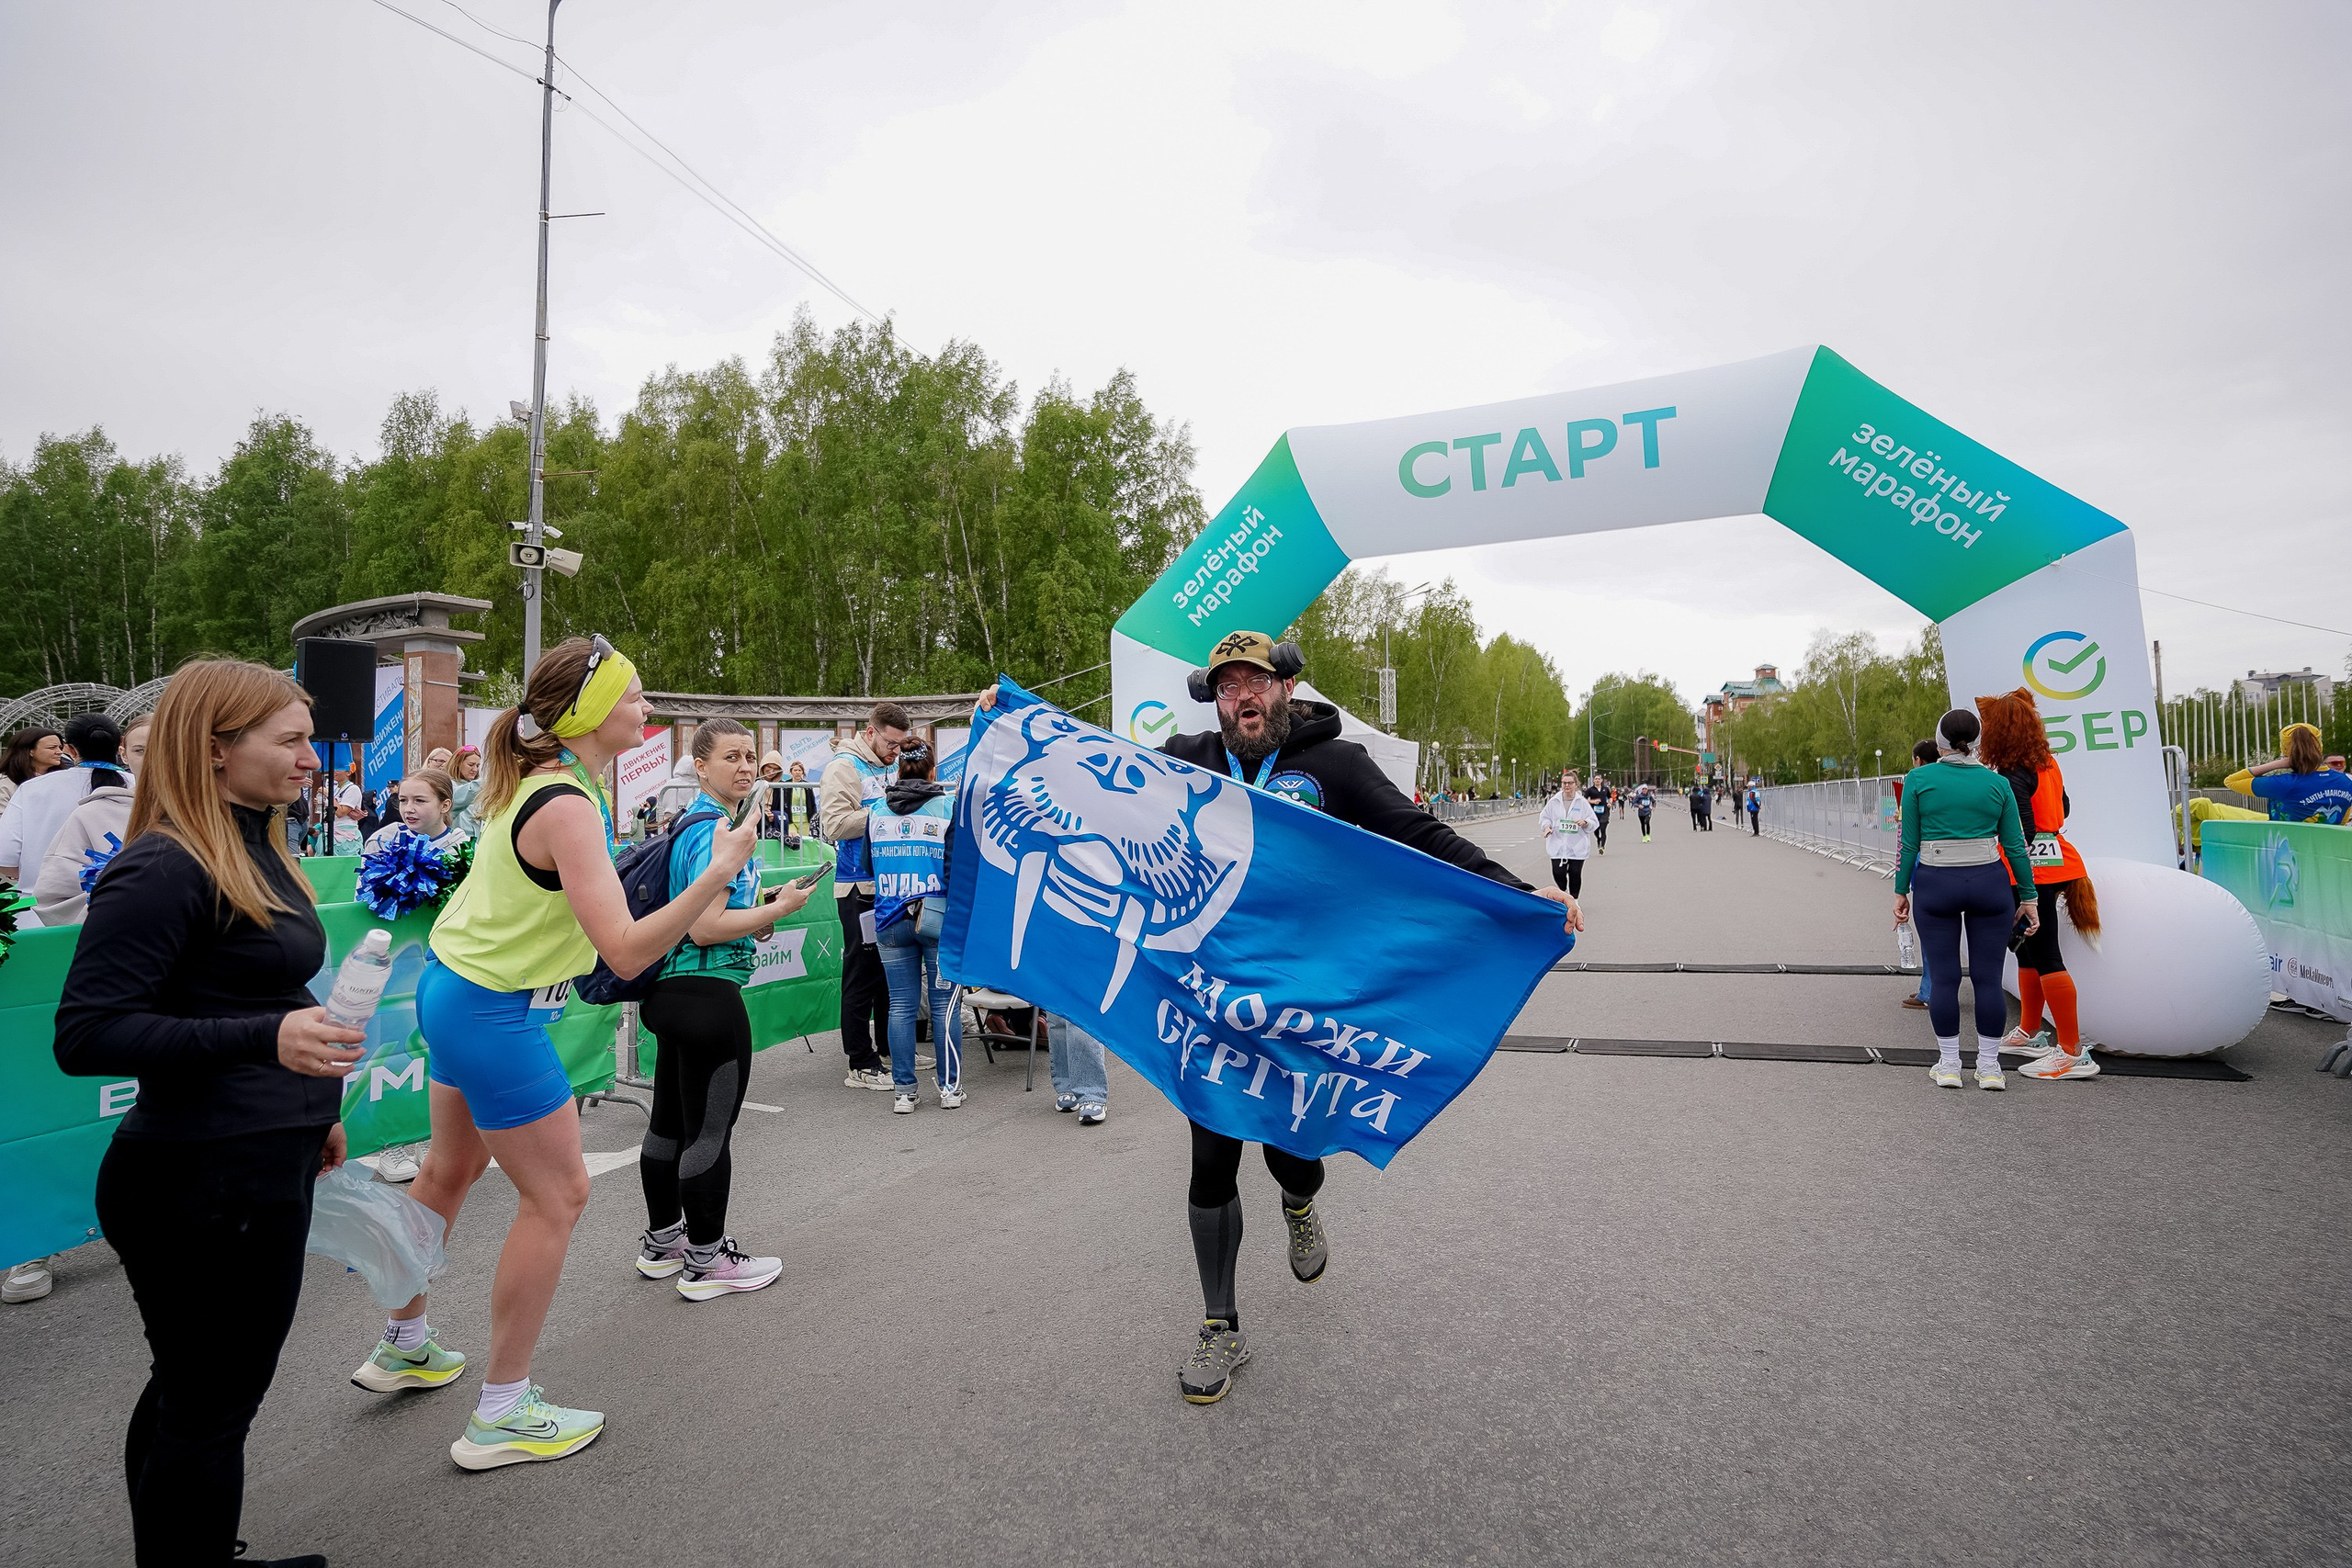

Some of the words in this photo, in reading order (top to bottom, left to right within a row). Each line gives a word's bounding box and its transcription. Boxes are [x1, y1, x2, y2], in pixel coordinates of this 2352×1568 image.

[1398, 405, 1678, 499] СТАРТ
[1851, 423, 2011, 523] зелёный
[1828, 446, 1983, 549] марафон
[1172, 504, 1265, 609] зелёный
[1187, 525, 1283, 627] марафон
[375, 675, 404, 712] СТИВАЛЬ
[789, 735, 813, 751] БЫТЬ
[792, 734, 830, 758] ДВИЖЕНИИ
[2041, 710, 2148, 753] БЕР
[620, 753, 669, 785] ПЕРВЫХ
[623, 742, 667, 772] ДВИЖЕНИЕ
[878, 873, 942, 898] СУДЬЯ
[751, 945, 792, 968] райм
[1178, 961, 1431, 1078] МОРЖИ
[1157, 998, 1402, 1134] СУРГУТА
